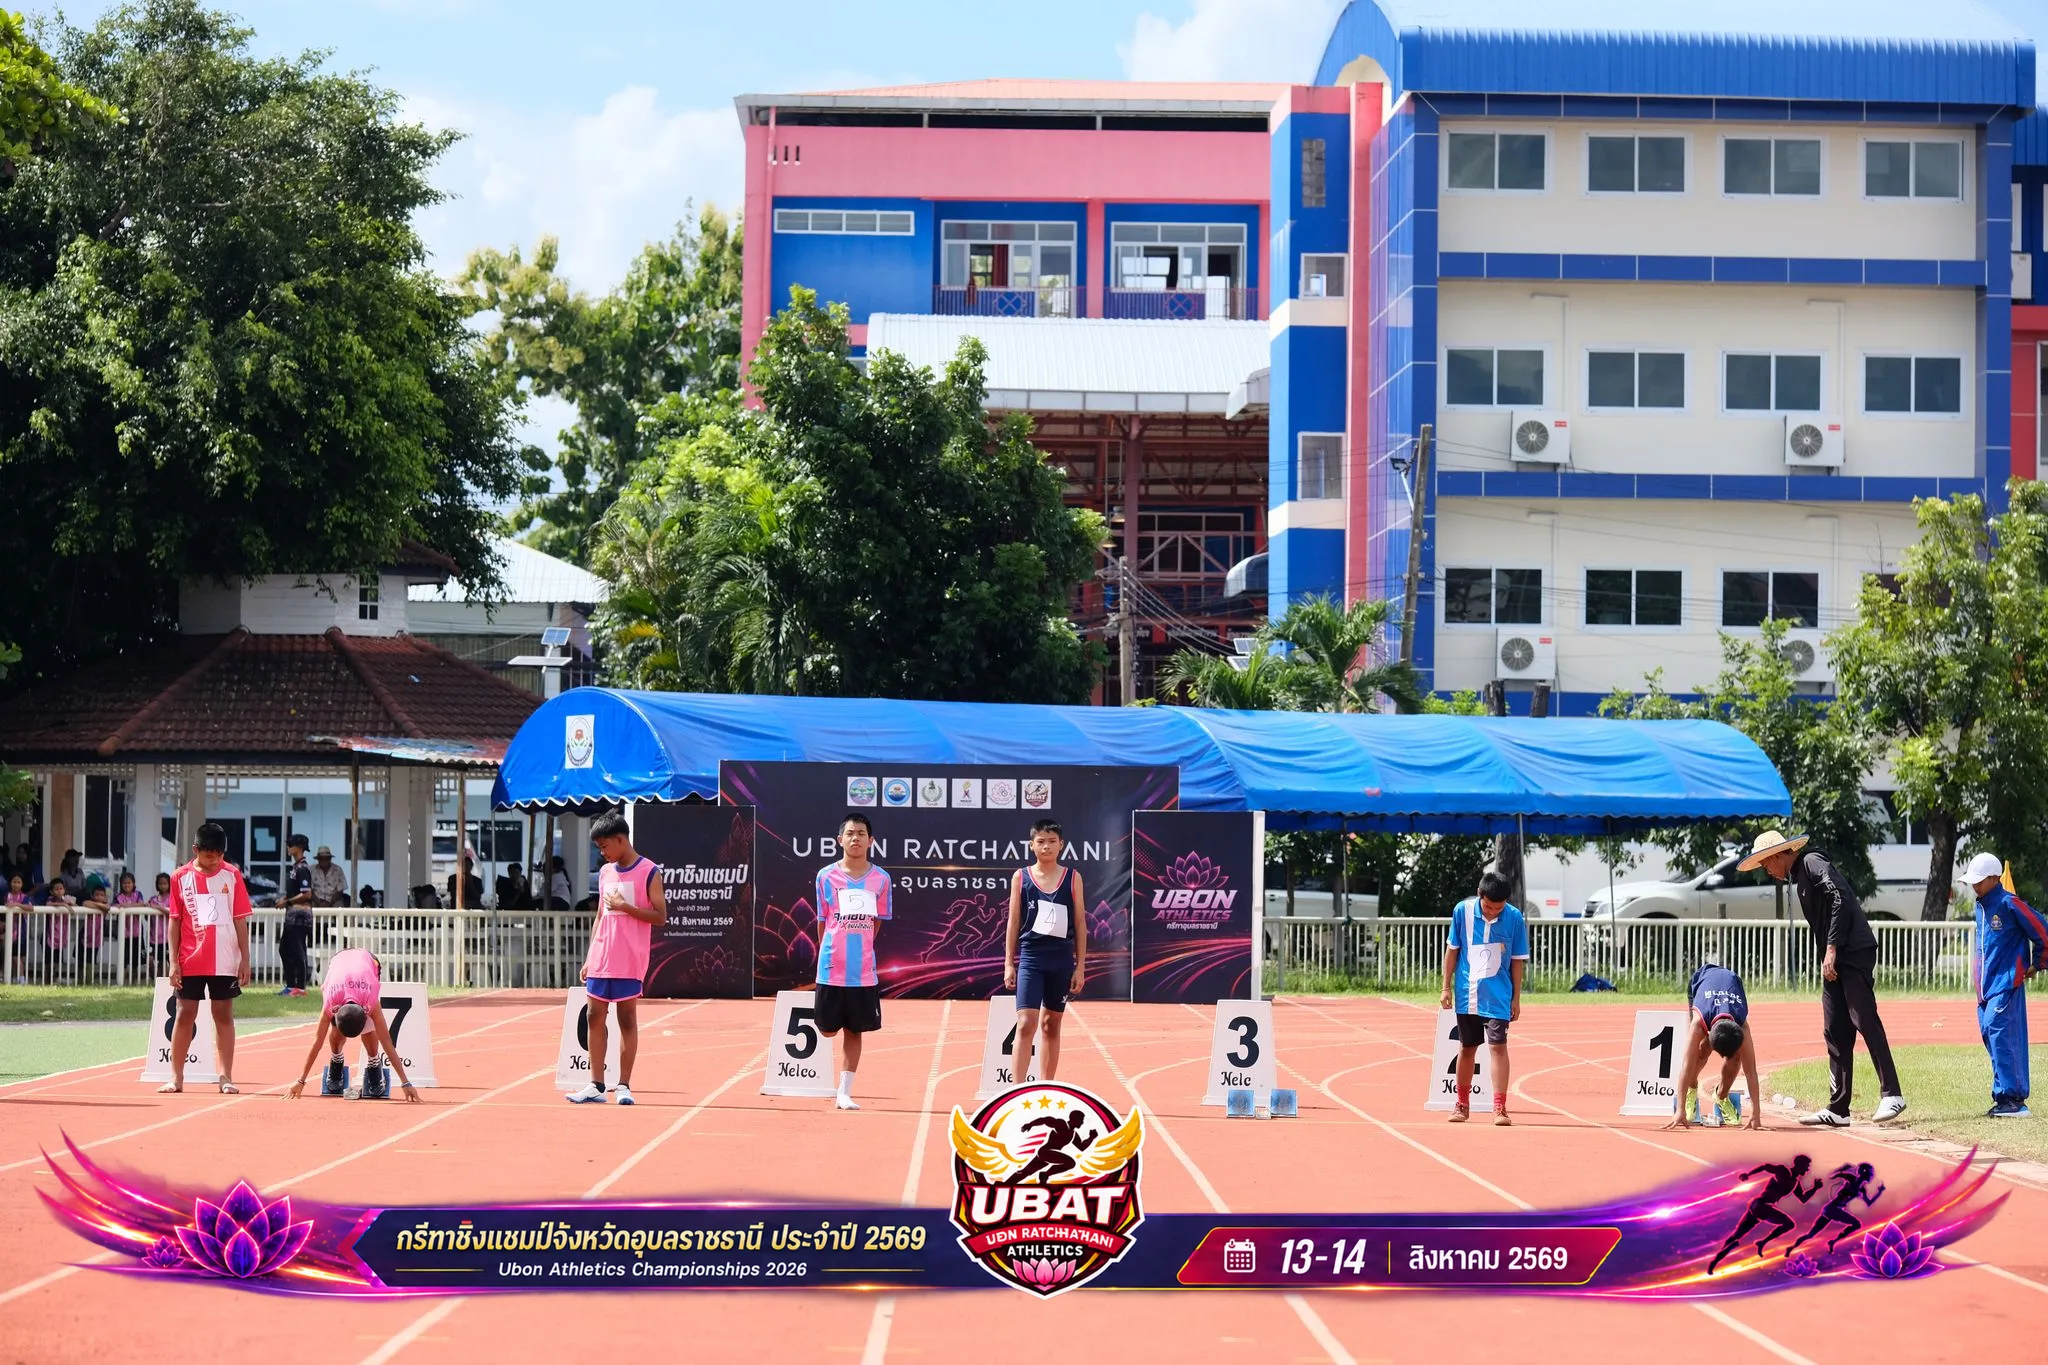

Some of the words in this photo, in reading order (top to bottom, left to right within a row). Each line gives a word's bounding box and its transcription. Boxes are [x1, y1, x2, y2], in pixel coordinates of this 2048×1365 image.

[793, 837, 887, 858] UBN
[904, 838, 1110, 861] RATCHATANI
[849, 894, 865, 911] 5
[1151, 889, 1238, 909] UBON
[682, 916, 711, 926] สิงหาคม
[713, 916, 734, 926] 2569
[1043, 907, 1057, 928] 4
[1152, 909, 1233, 921] ATHLETICS
[1477, 948, 1492, 974] 2
[380, 997, 412, 1049] 7
[784, 1007, 818, 1060] 5
[1226, 1016, 1260, 1068] 3
[1649, 1026, 1674, 1079] 1
[778, 1062, 817, 1079] Nelco
[1637, 1080, 1675, 1097] Nelco
